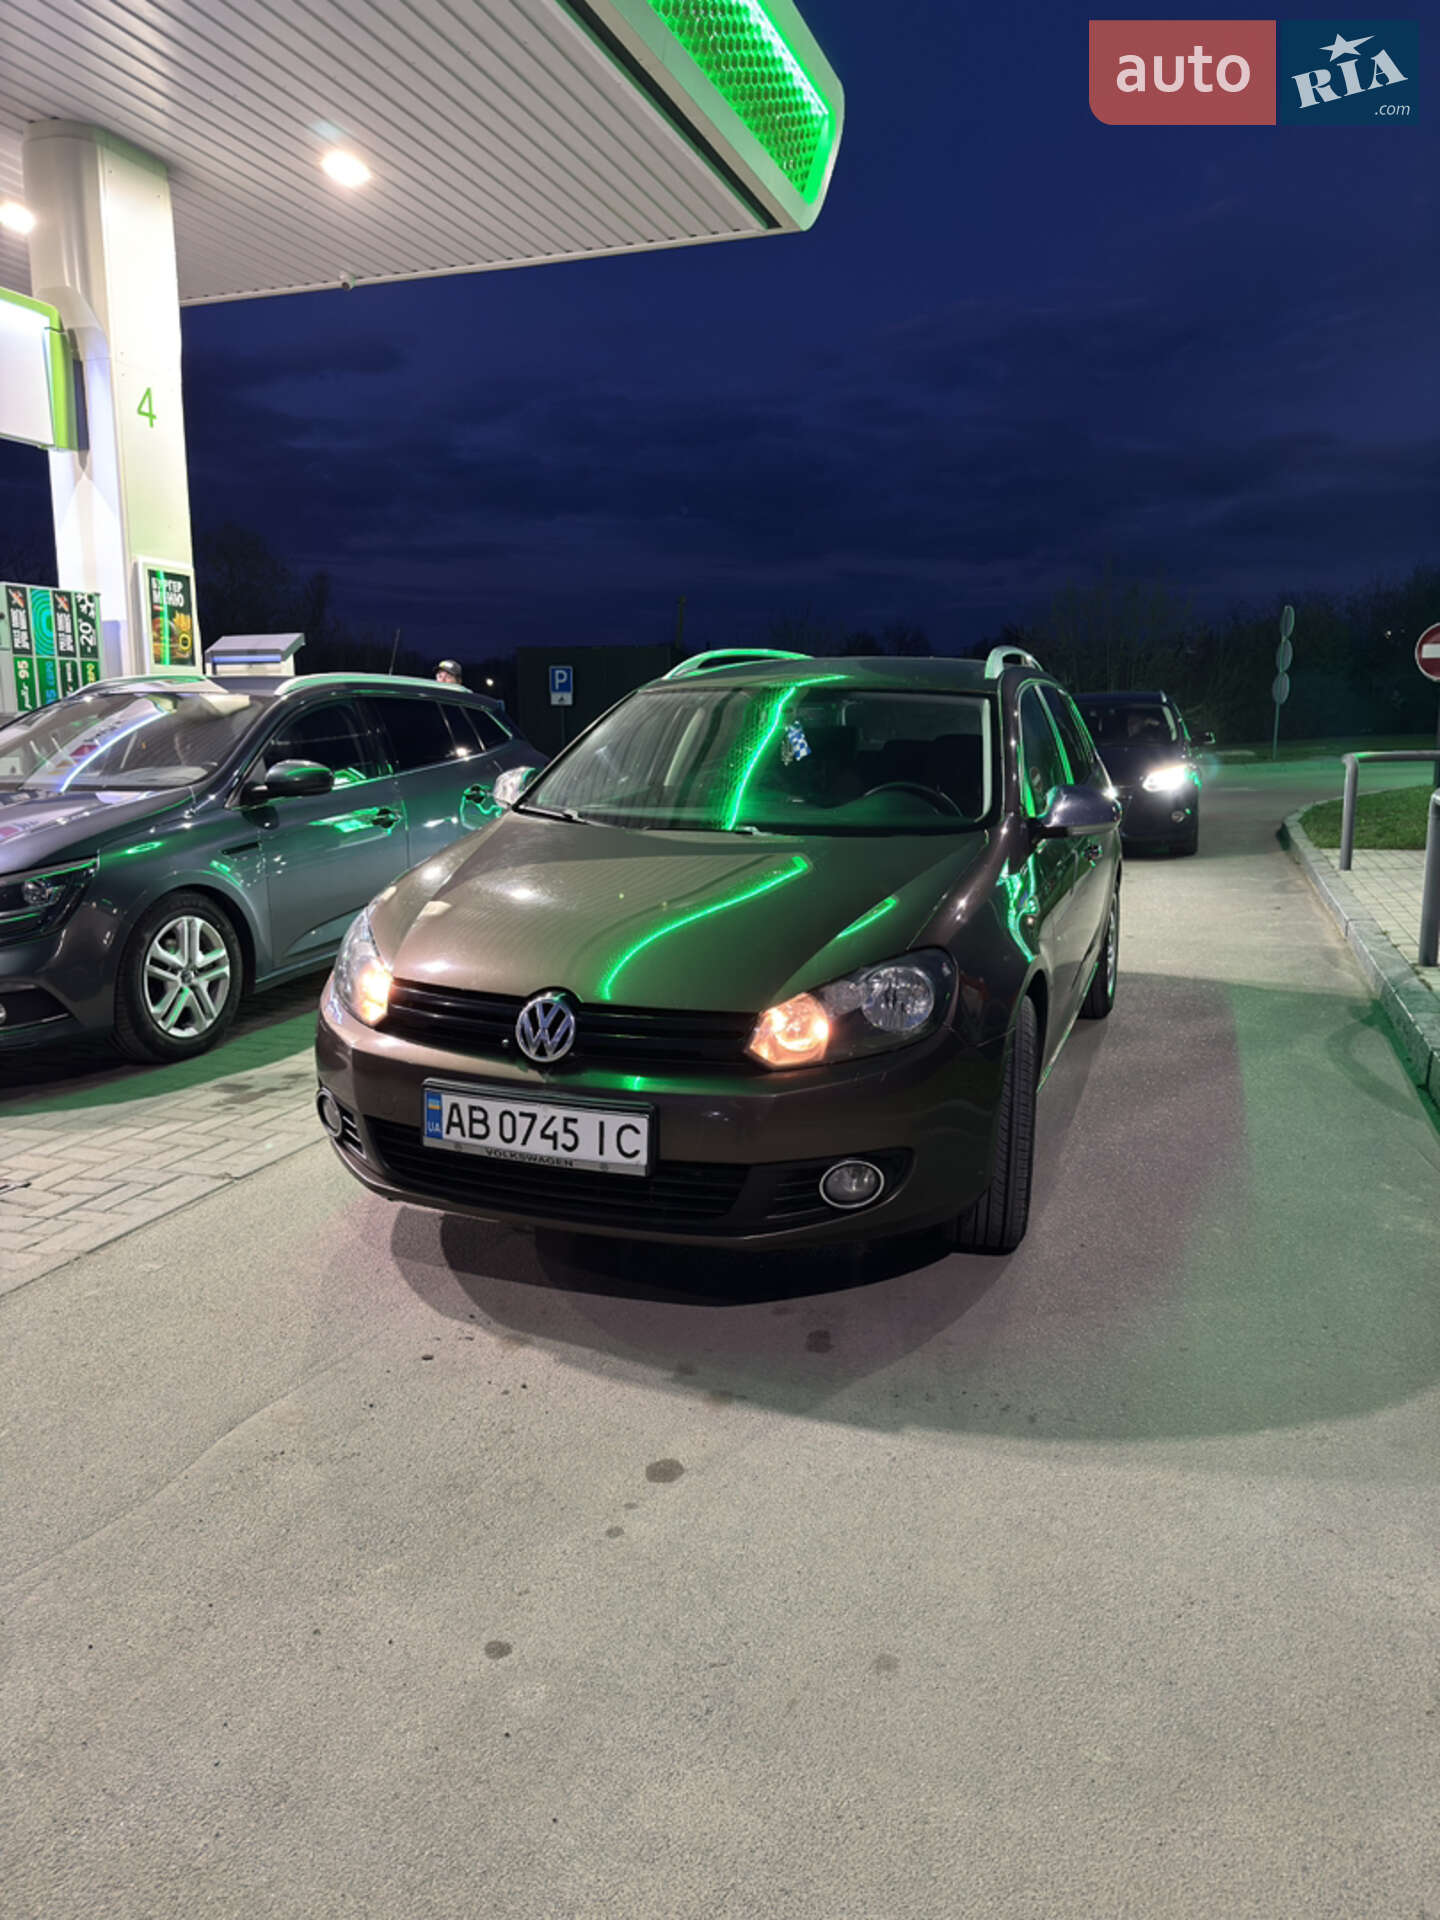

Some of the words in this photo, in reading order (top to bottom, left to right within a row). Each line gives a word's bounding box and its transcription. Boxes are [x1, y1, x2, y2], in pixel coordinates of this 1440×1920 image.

[137, 387, 157, 428] 4
[17, 660, 30, 680] 95
[554, 670, 567, 690] P
[426, 1120, 441, 1133] UA
[445, 1102, 490, 1140] AB
[499, 1110, 579, 1152] 0745
[598, 1121, 641, 1158] IC
[484, 1145, 574, 1168] VOLKSWAGEN
